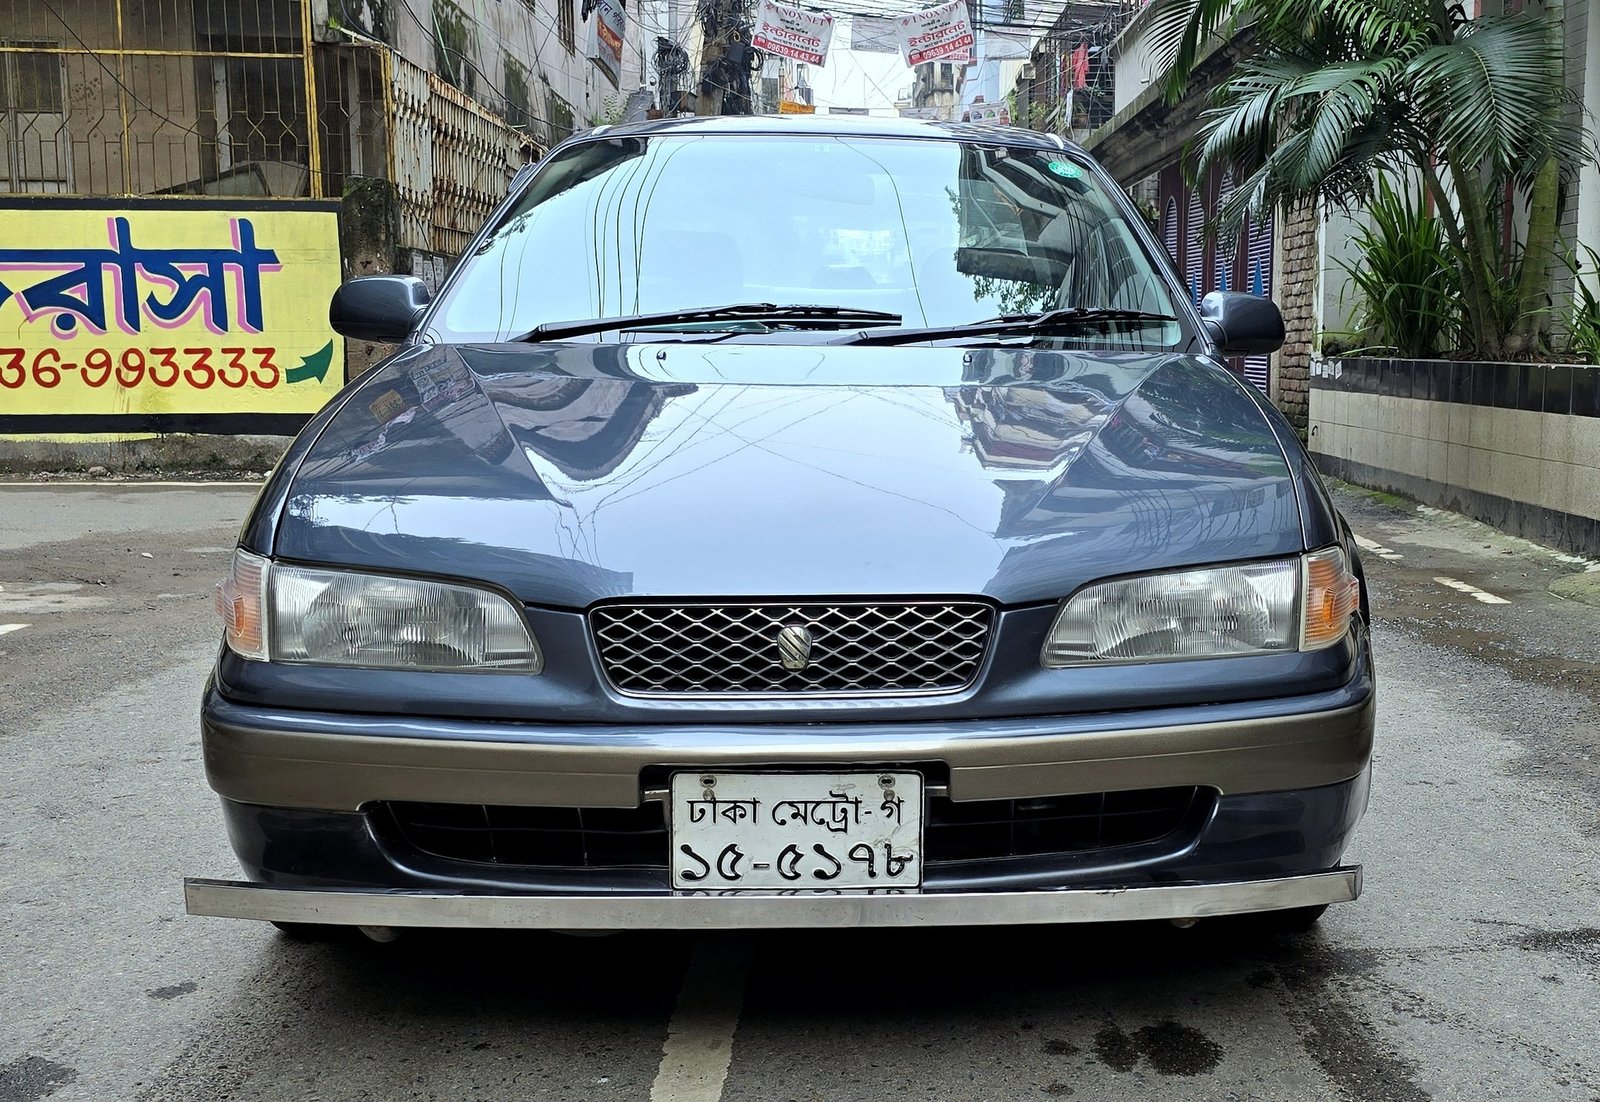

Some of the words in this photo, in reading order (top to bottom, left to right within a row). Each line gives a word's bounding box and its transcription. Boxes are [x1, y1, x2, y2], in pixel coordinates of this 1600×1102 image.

[806, 14, 825, 26] NET
[941, 2, 960, 13] NET
[762, 21, 821, 48] ইন্টারনেট
[908, 20, 965, 47] ইন্টারনেট
[800, 52, 809, 61] 43
[810, 55, 820, 64] 44
[0, 216, 284, 340] রাসা
[686, 797, 761, 824] ঢাকা
[680, 843, 914, 881] ১৫-৫১৭৮
